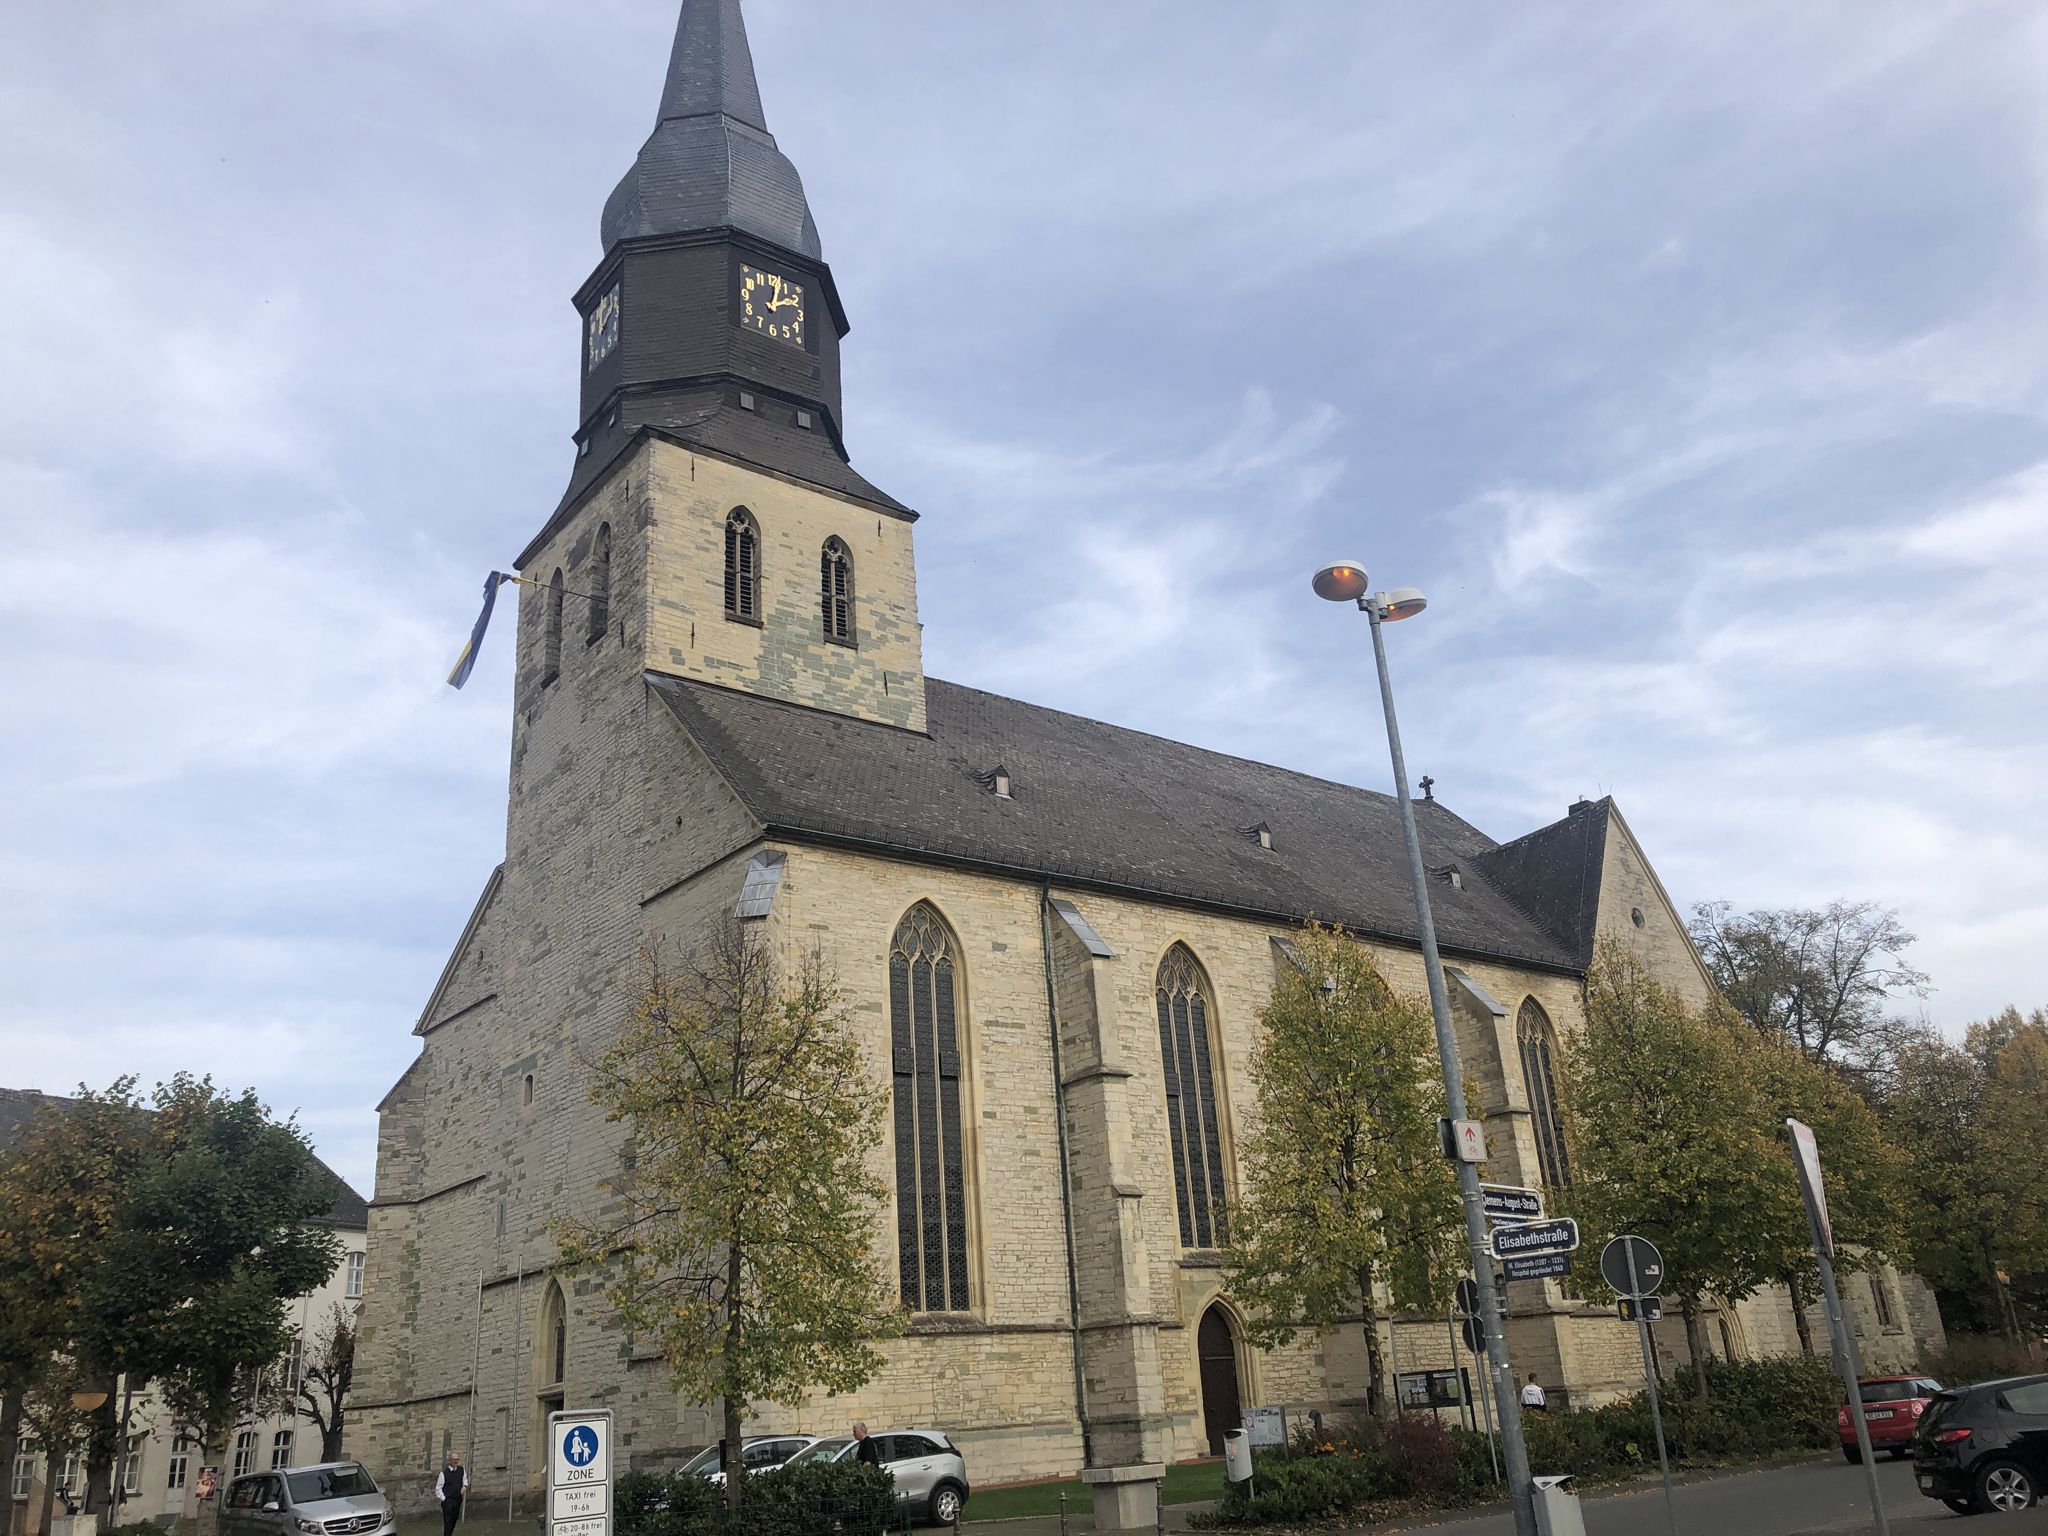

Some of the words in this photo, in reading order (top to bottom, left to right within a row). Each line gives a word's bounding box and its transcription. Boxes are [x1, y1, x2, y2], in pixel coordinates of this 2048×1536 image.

[756, 272, 764, 286] 11
[741, 288, 750, 301] 9
[783, 283, 788, 295] 1
[791, 294, 799, 307] 2
[745, 303, 753, 316] 8
[796, 310, 804, 322] 3
[756, 315, 764, 329] 7
[792, 321, 799, 334] 4
[769, 324, 777, 337] 6
[782, 325, 790, 339] 5
[1498, 1228, 1569, 1250] Elisabethstraße
[567, 1468, 594, 1481] ZONE
[565, 1492, 581, 1501] TAXI
[583, 1490, 596, 1499] frei
[591, 1521, 603, 1529] frei
